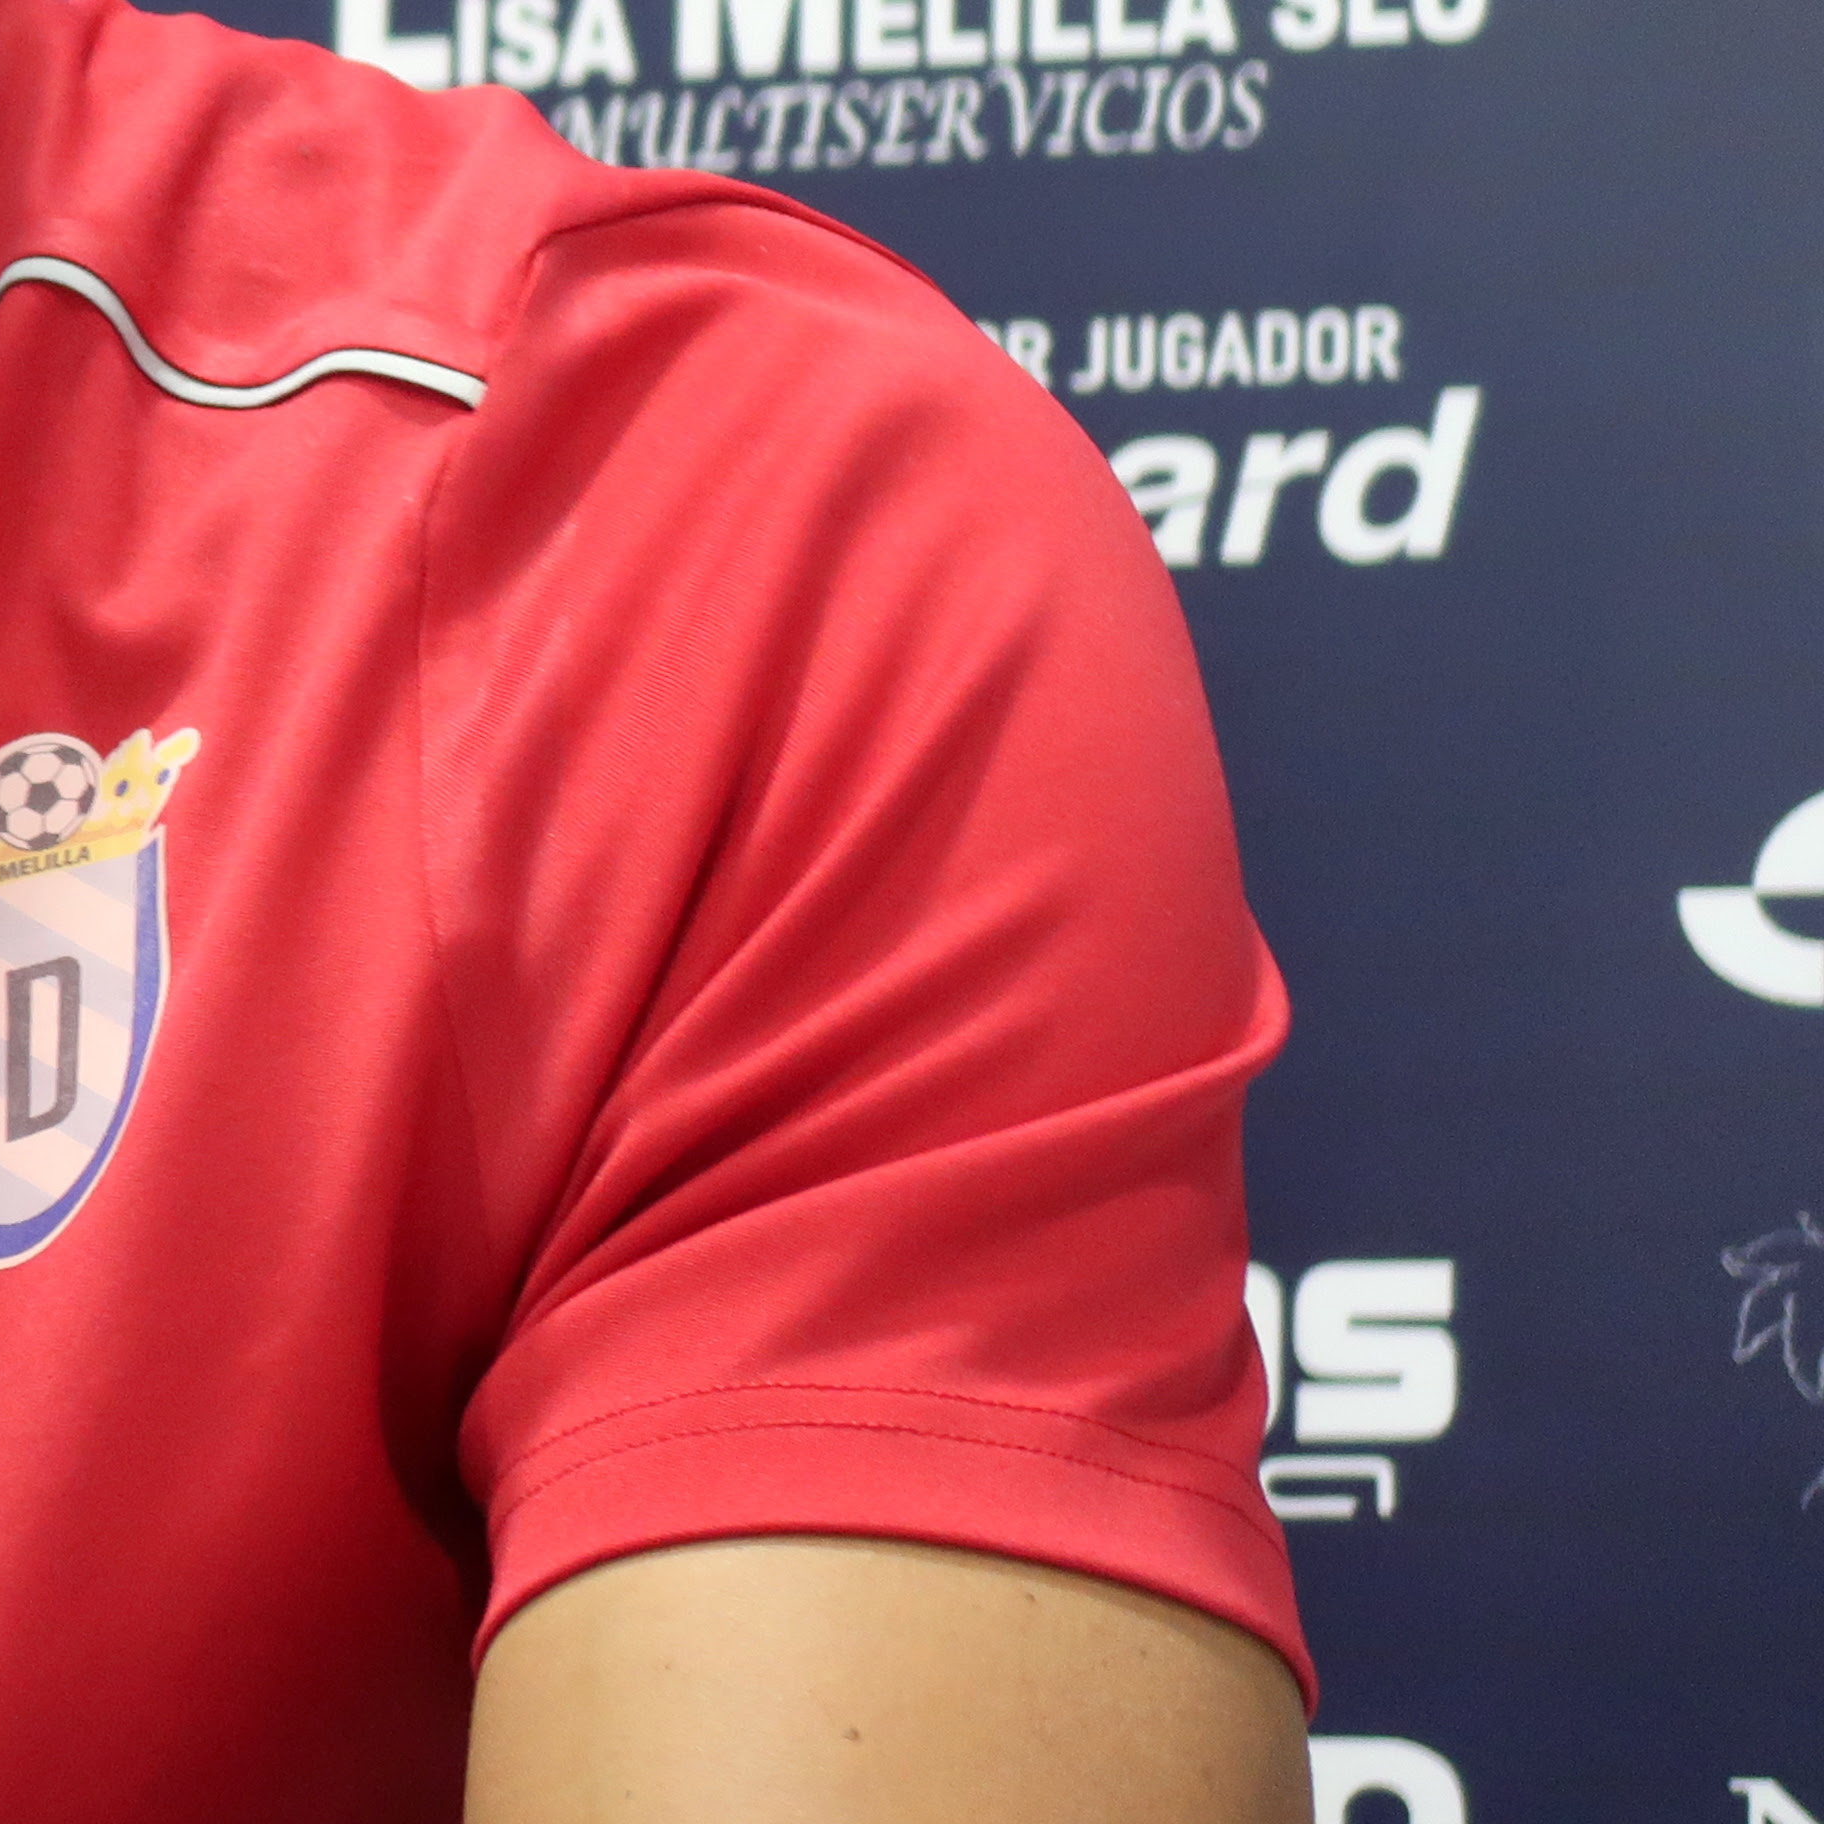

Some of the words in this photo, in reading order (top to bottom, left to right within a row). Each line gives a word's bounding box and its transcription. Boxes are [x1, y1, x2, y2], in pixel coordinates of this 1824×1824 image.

[550, 60, 1270, 174] MULTISERVICIOS
[1071, 304, 1404, 394] JUGADOR
[5, 955, 82, 1143] D
